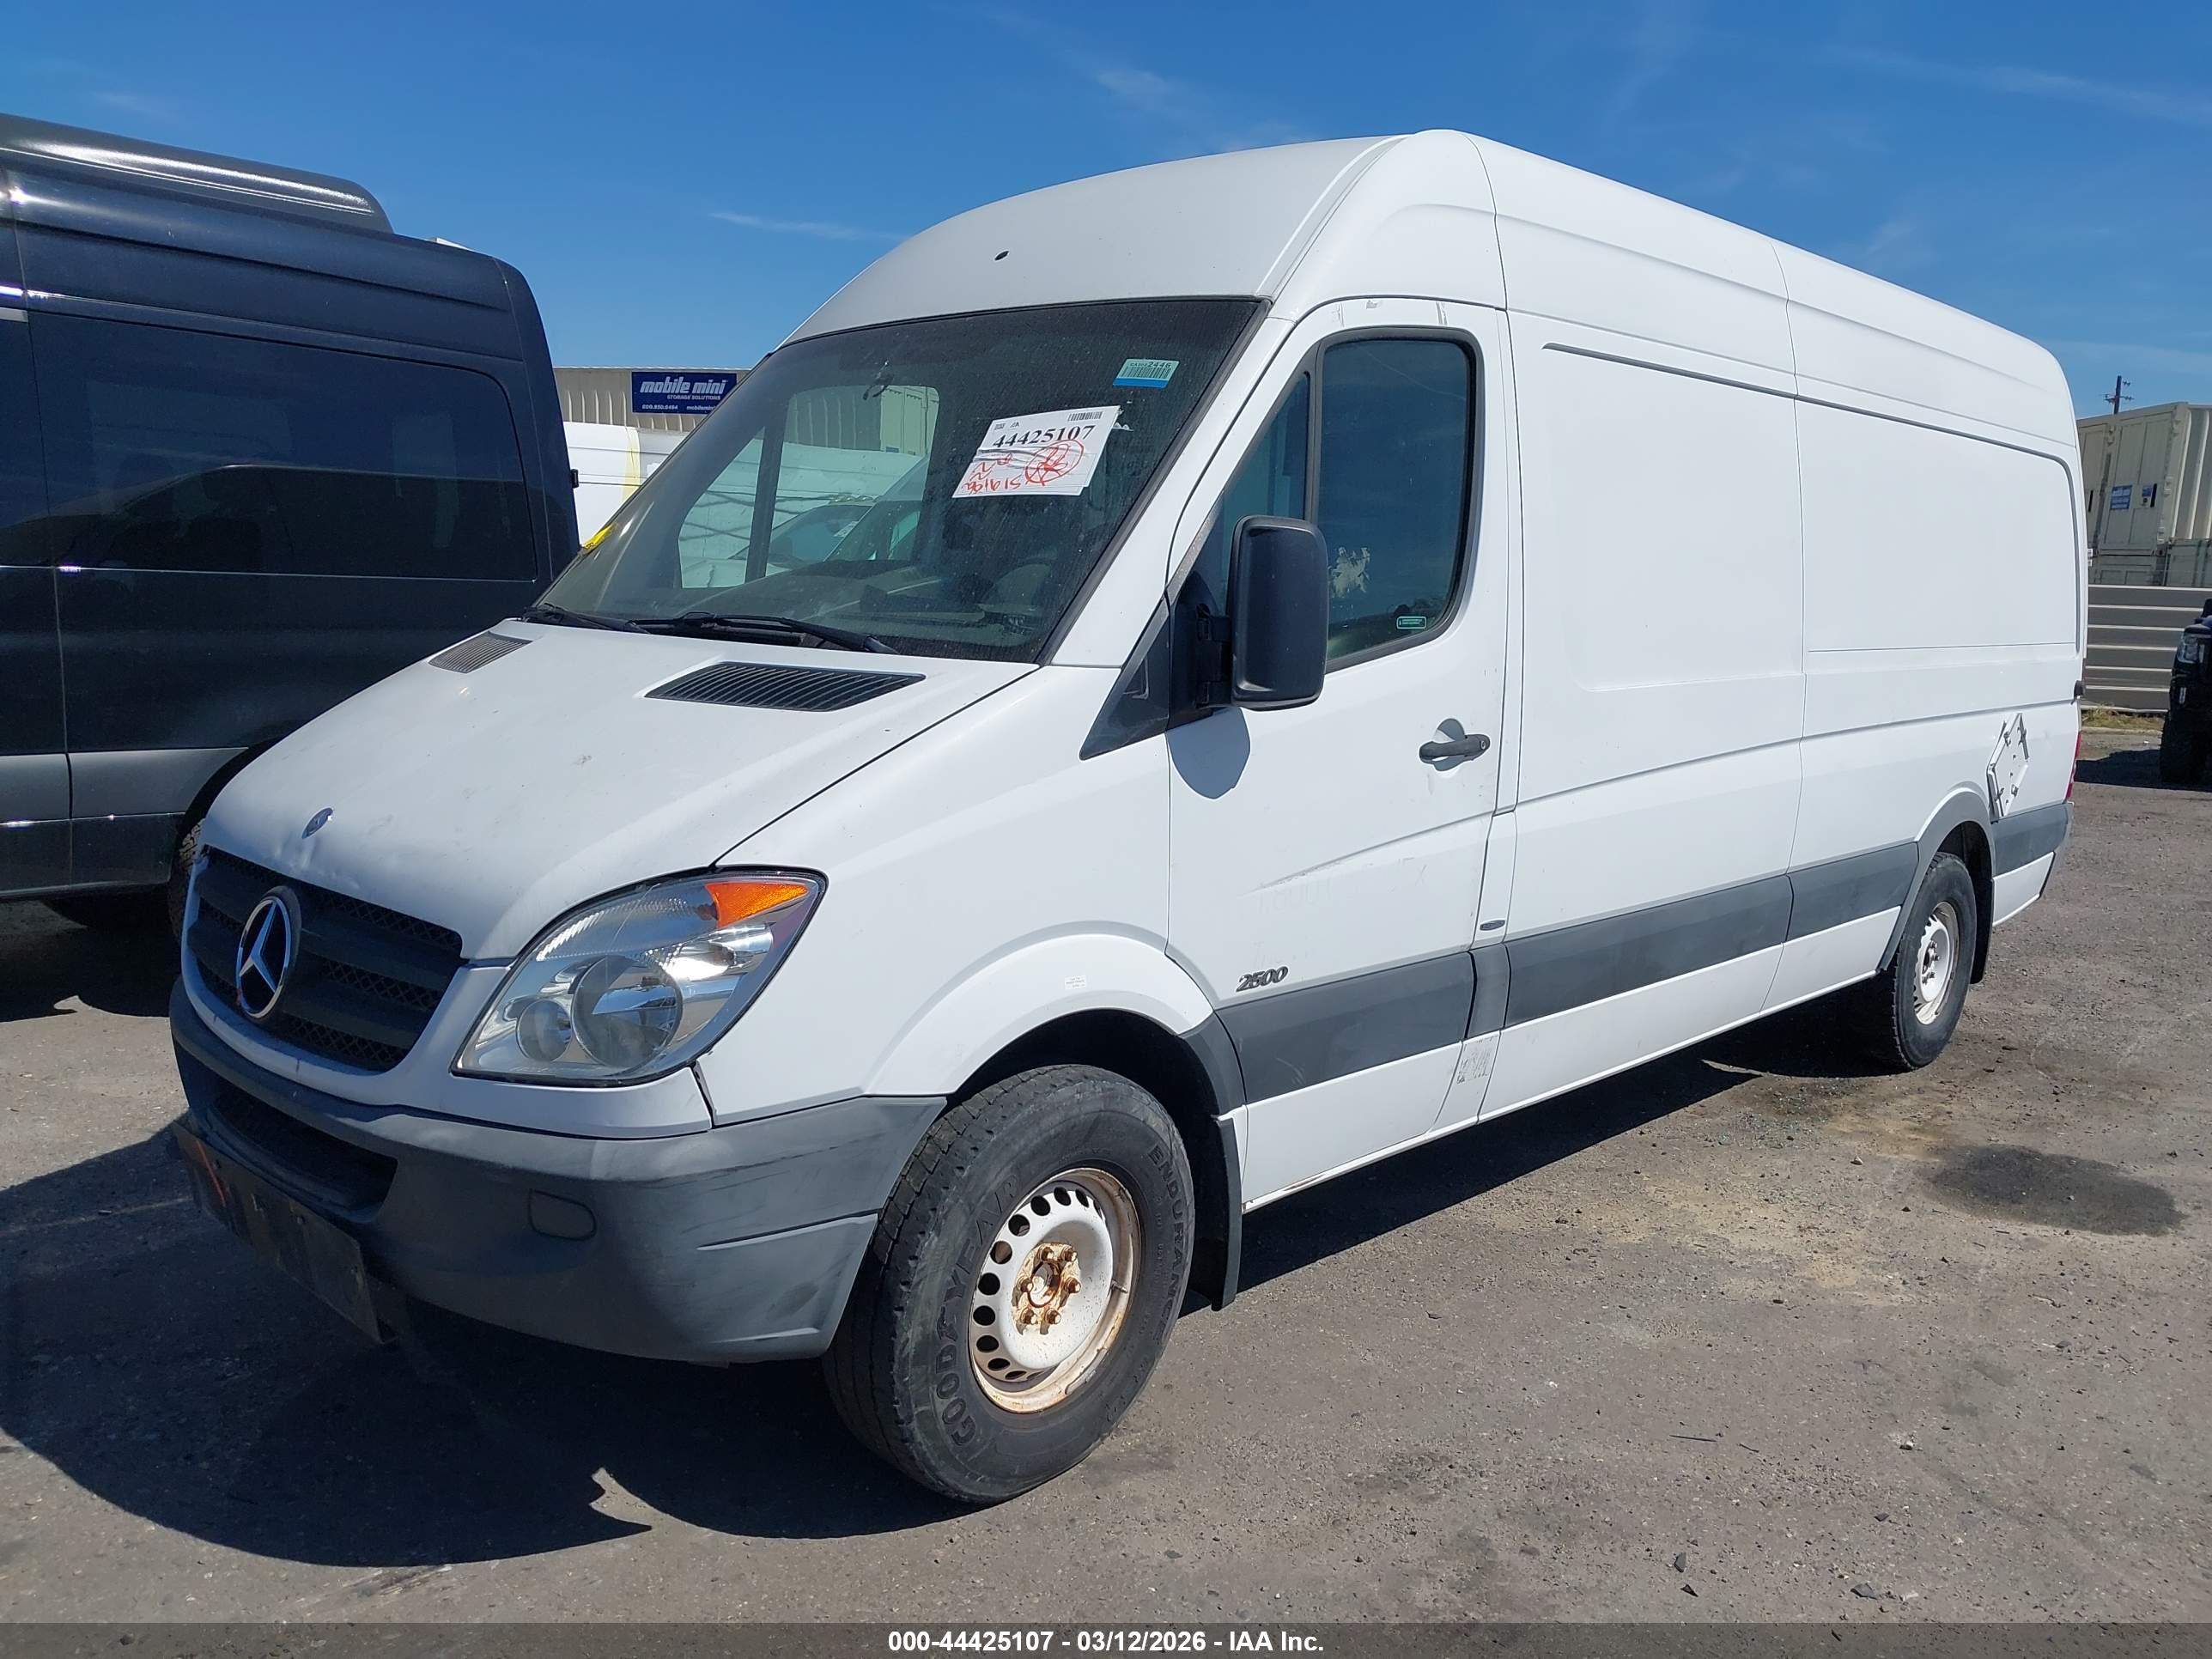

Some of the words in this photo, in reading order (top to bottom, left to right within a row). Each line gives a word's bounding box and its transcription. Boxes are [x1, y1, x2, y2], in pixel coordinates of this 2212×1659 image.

[640, 376, 690, 394] mobile
[692, 380, 726, 394] mini
[993, 425, 1096, 448] 44425107
[1236, 966, 1289, 992] 2500
[1147, 1144, 1187, 1342] ENDURANCE
[936, 1174, 1019, 1447] GOODYEAR
